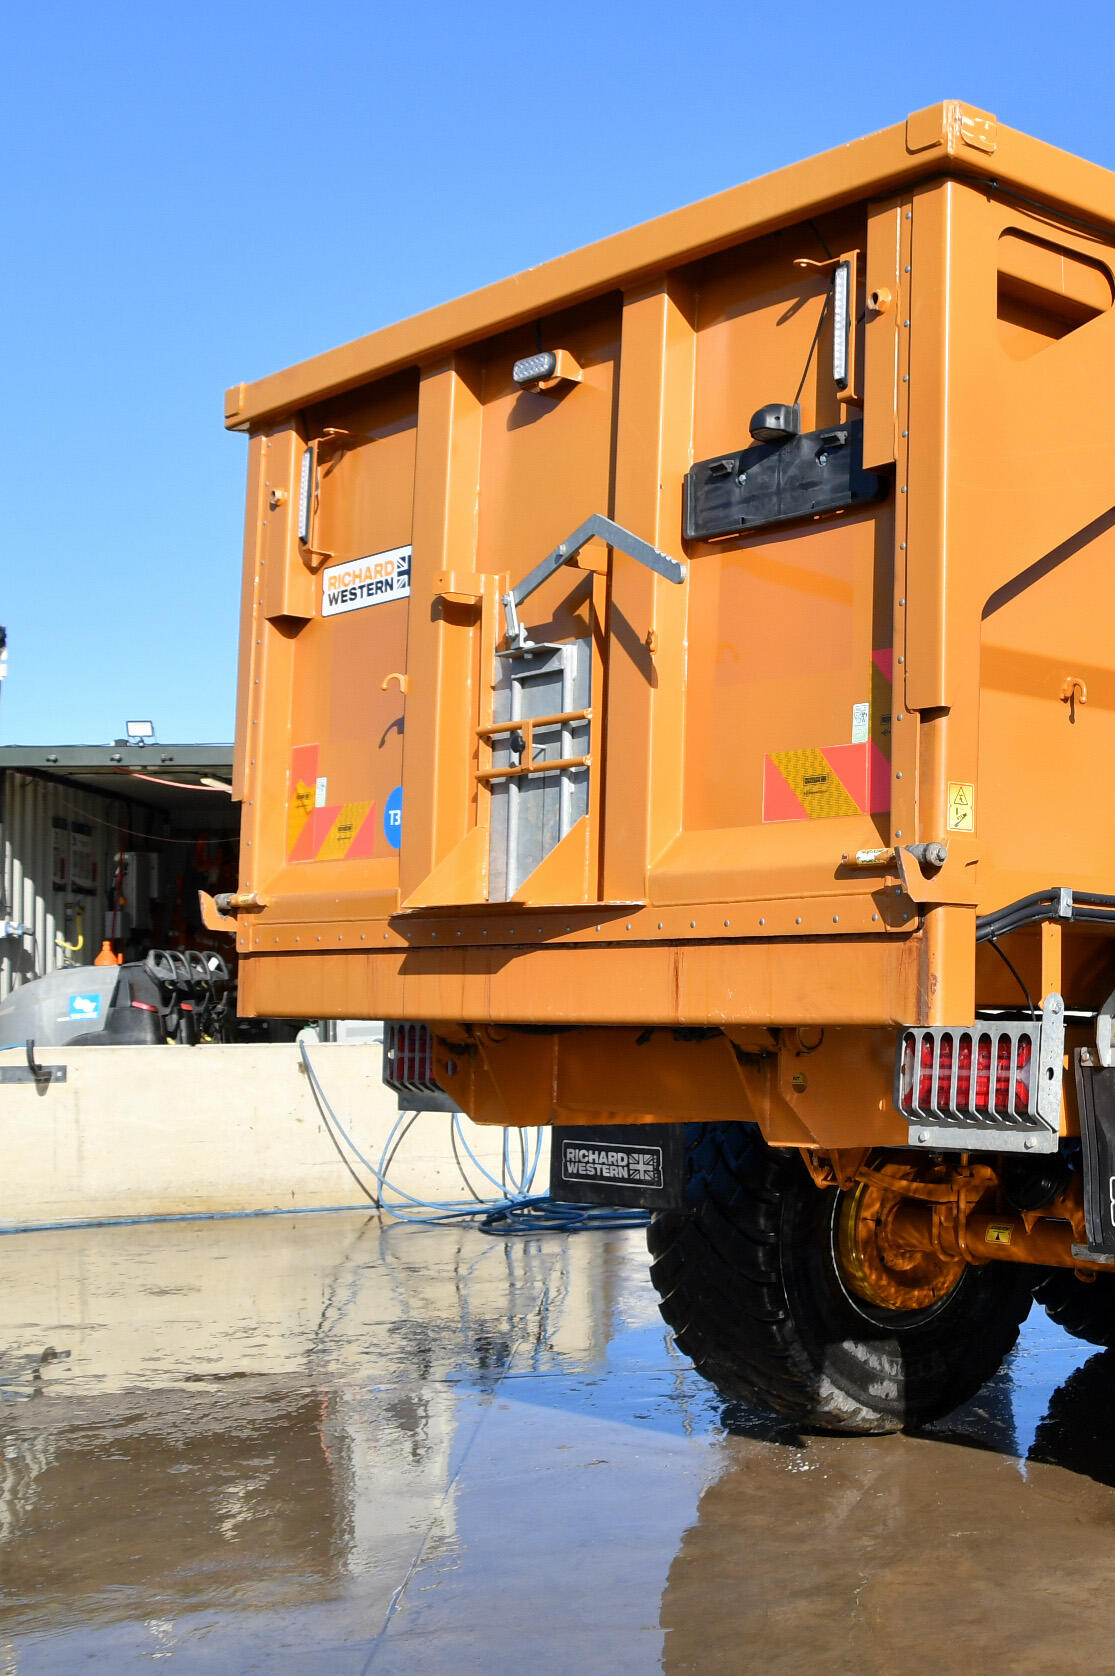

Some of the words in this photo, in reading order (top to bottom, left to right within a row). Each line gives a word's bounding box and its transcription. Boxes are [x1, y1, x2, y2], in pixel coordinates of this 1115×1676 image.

[328, 560, 394, 590] RICHARD
[328, 577, 394, 606] WESTERN
[566, 1148, 628, 1166] RICHARD
[566, 1161, 629, 1178] WESTERN
